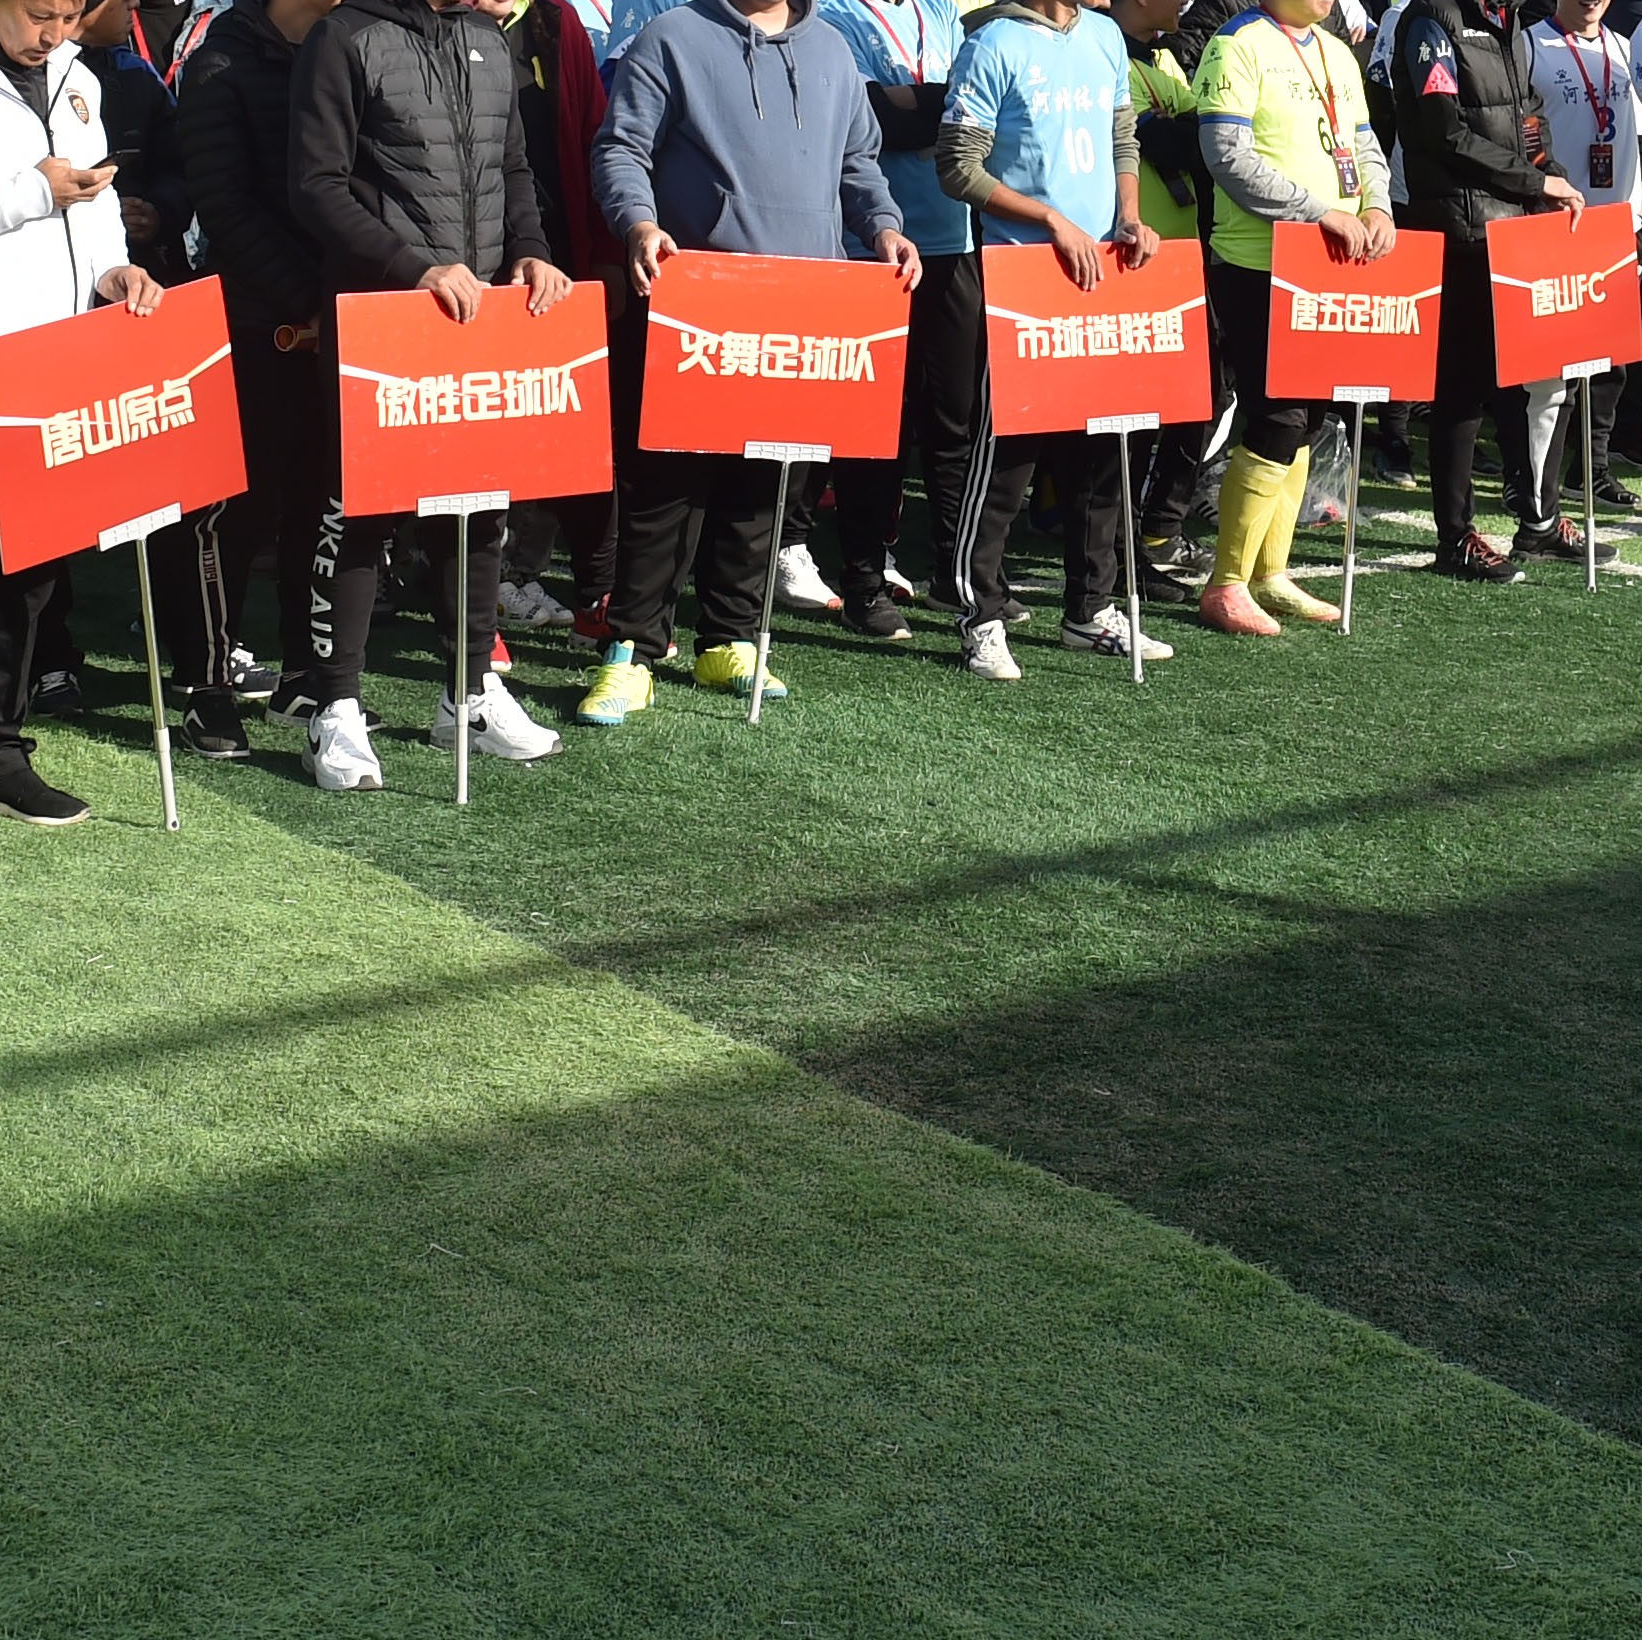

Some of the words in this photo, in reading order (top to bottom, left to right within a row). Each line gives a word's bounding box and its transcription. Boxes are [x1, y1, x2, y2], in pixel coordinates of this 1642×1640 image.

[1064, 127, 1095, 174] 10
[1290, 292, 1420, 335] 唐五足球队
[1531, 271, 1607, 317] 唐山FC
[677, 331, 876, 382] 火舞足球队
[1015, 311, 1185, 359] 市球迷联盟
[375, 366, 582, 428] 傲胜足球队
[41, 378, 196, 469] 唐山原点
[313, 496, 344, 578] NKE
[310, 586, 333, 658] AIR
